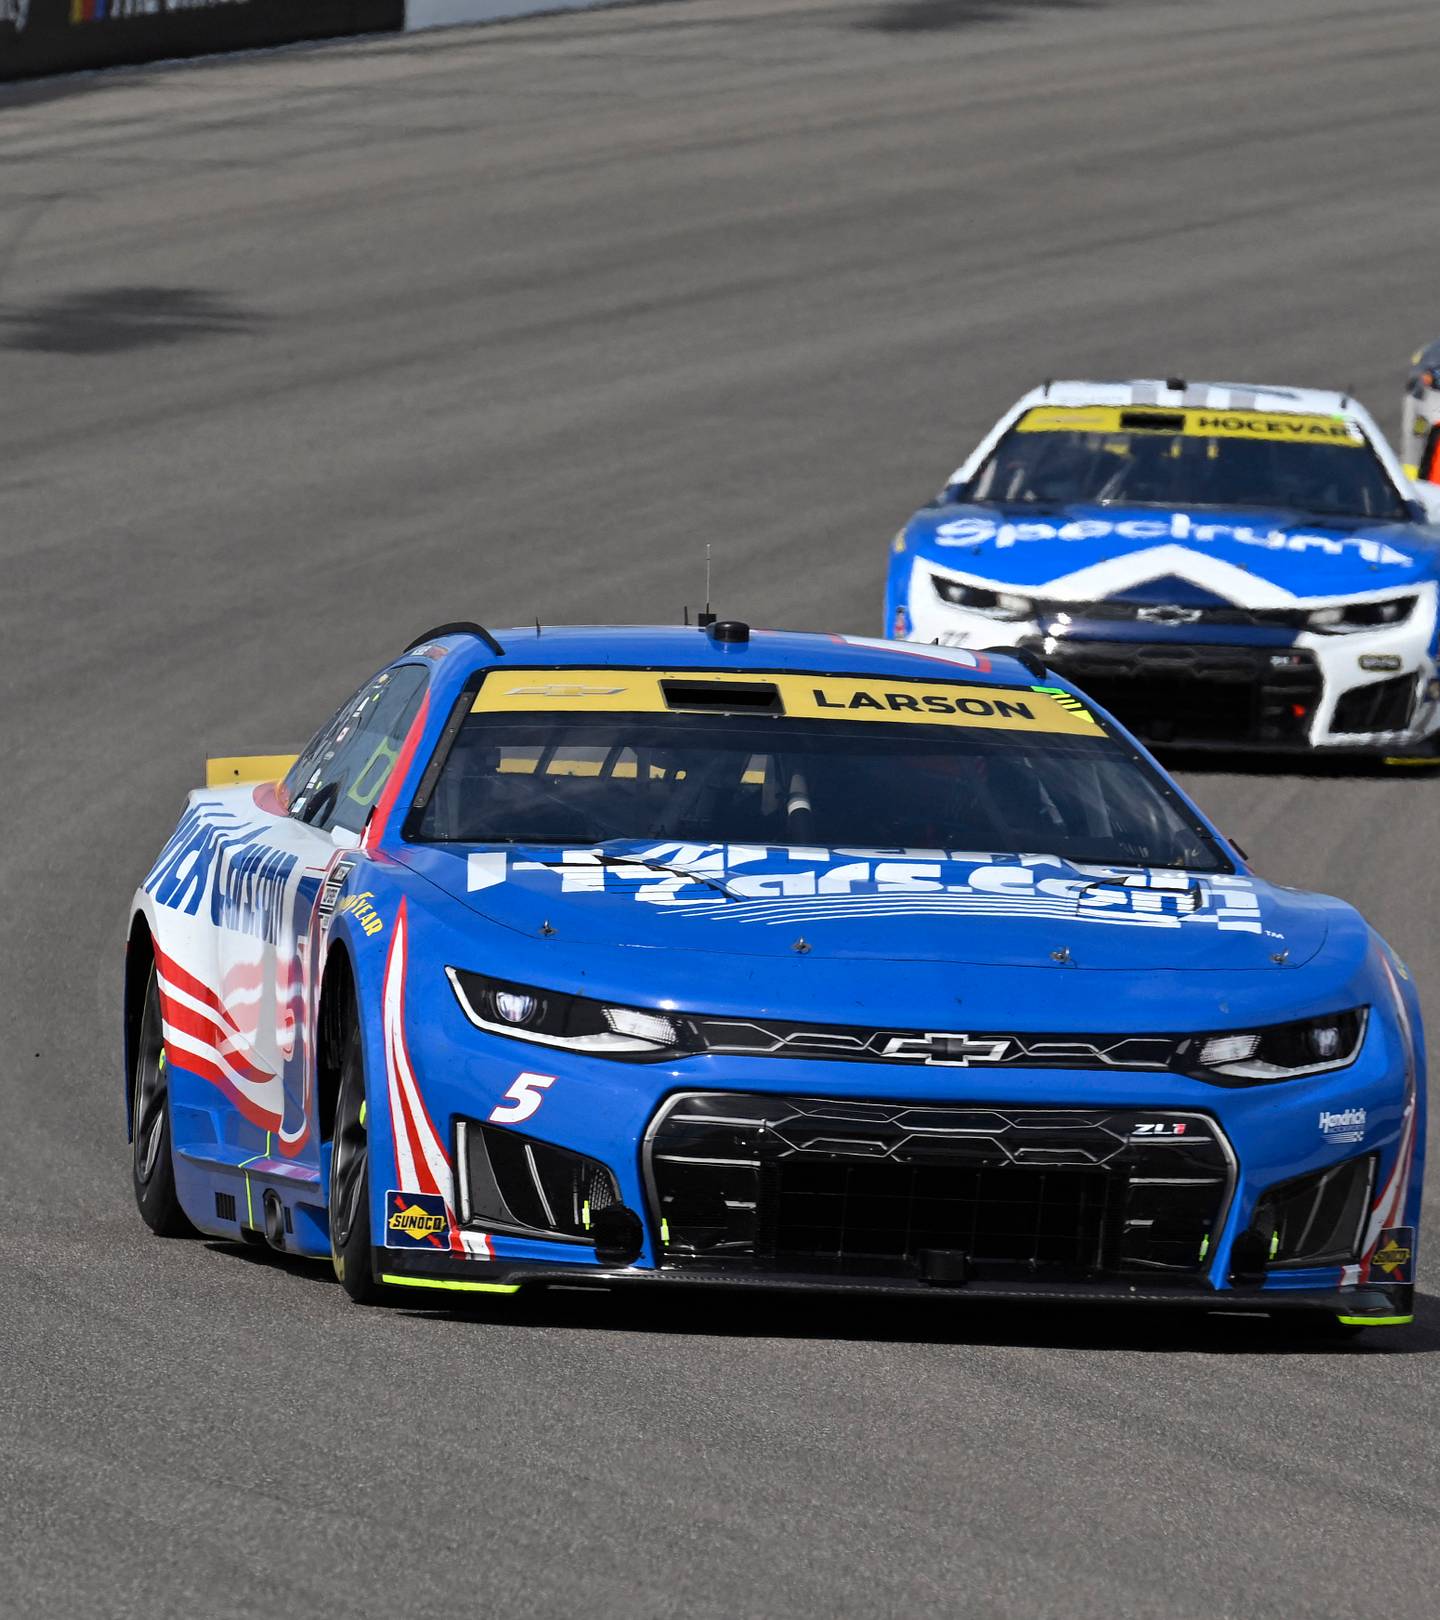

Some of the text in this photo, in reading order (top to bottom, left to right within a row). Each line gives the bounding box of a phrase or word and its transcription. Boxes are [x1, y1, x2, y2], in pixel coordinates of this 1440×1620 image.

[1199, 416, 1348, 436] HOCEVAR
[935, 513, 1371, 556] Spectrum
[813, 688, 1035, 720] LARSON
[489, 1073, 559, 1124] 5
[1132, 1123, 1186, 1135] ZL1
[392, 1214, 442, 1231] SUNOCO
